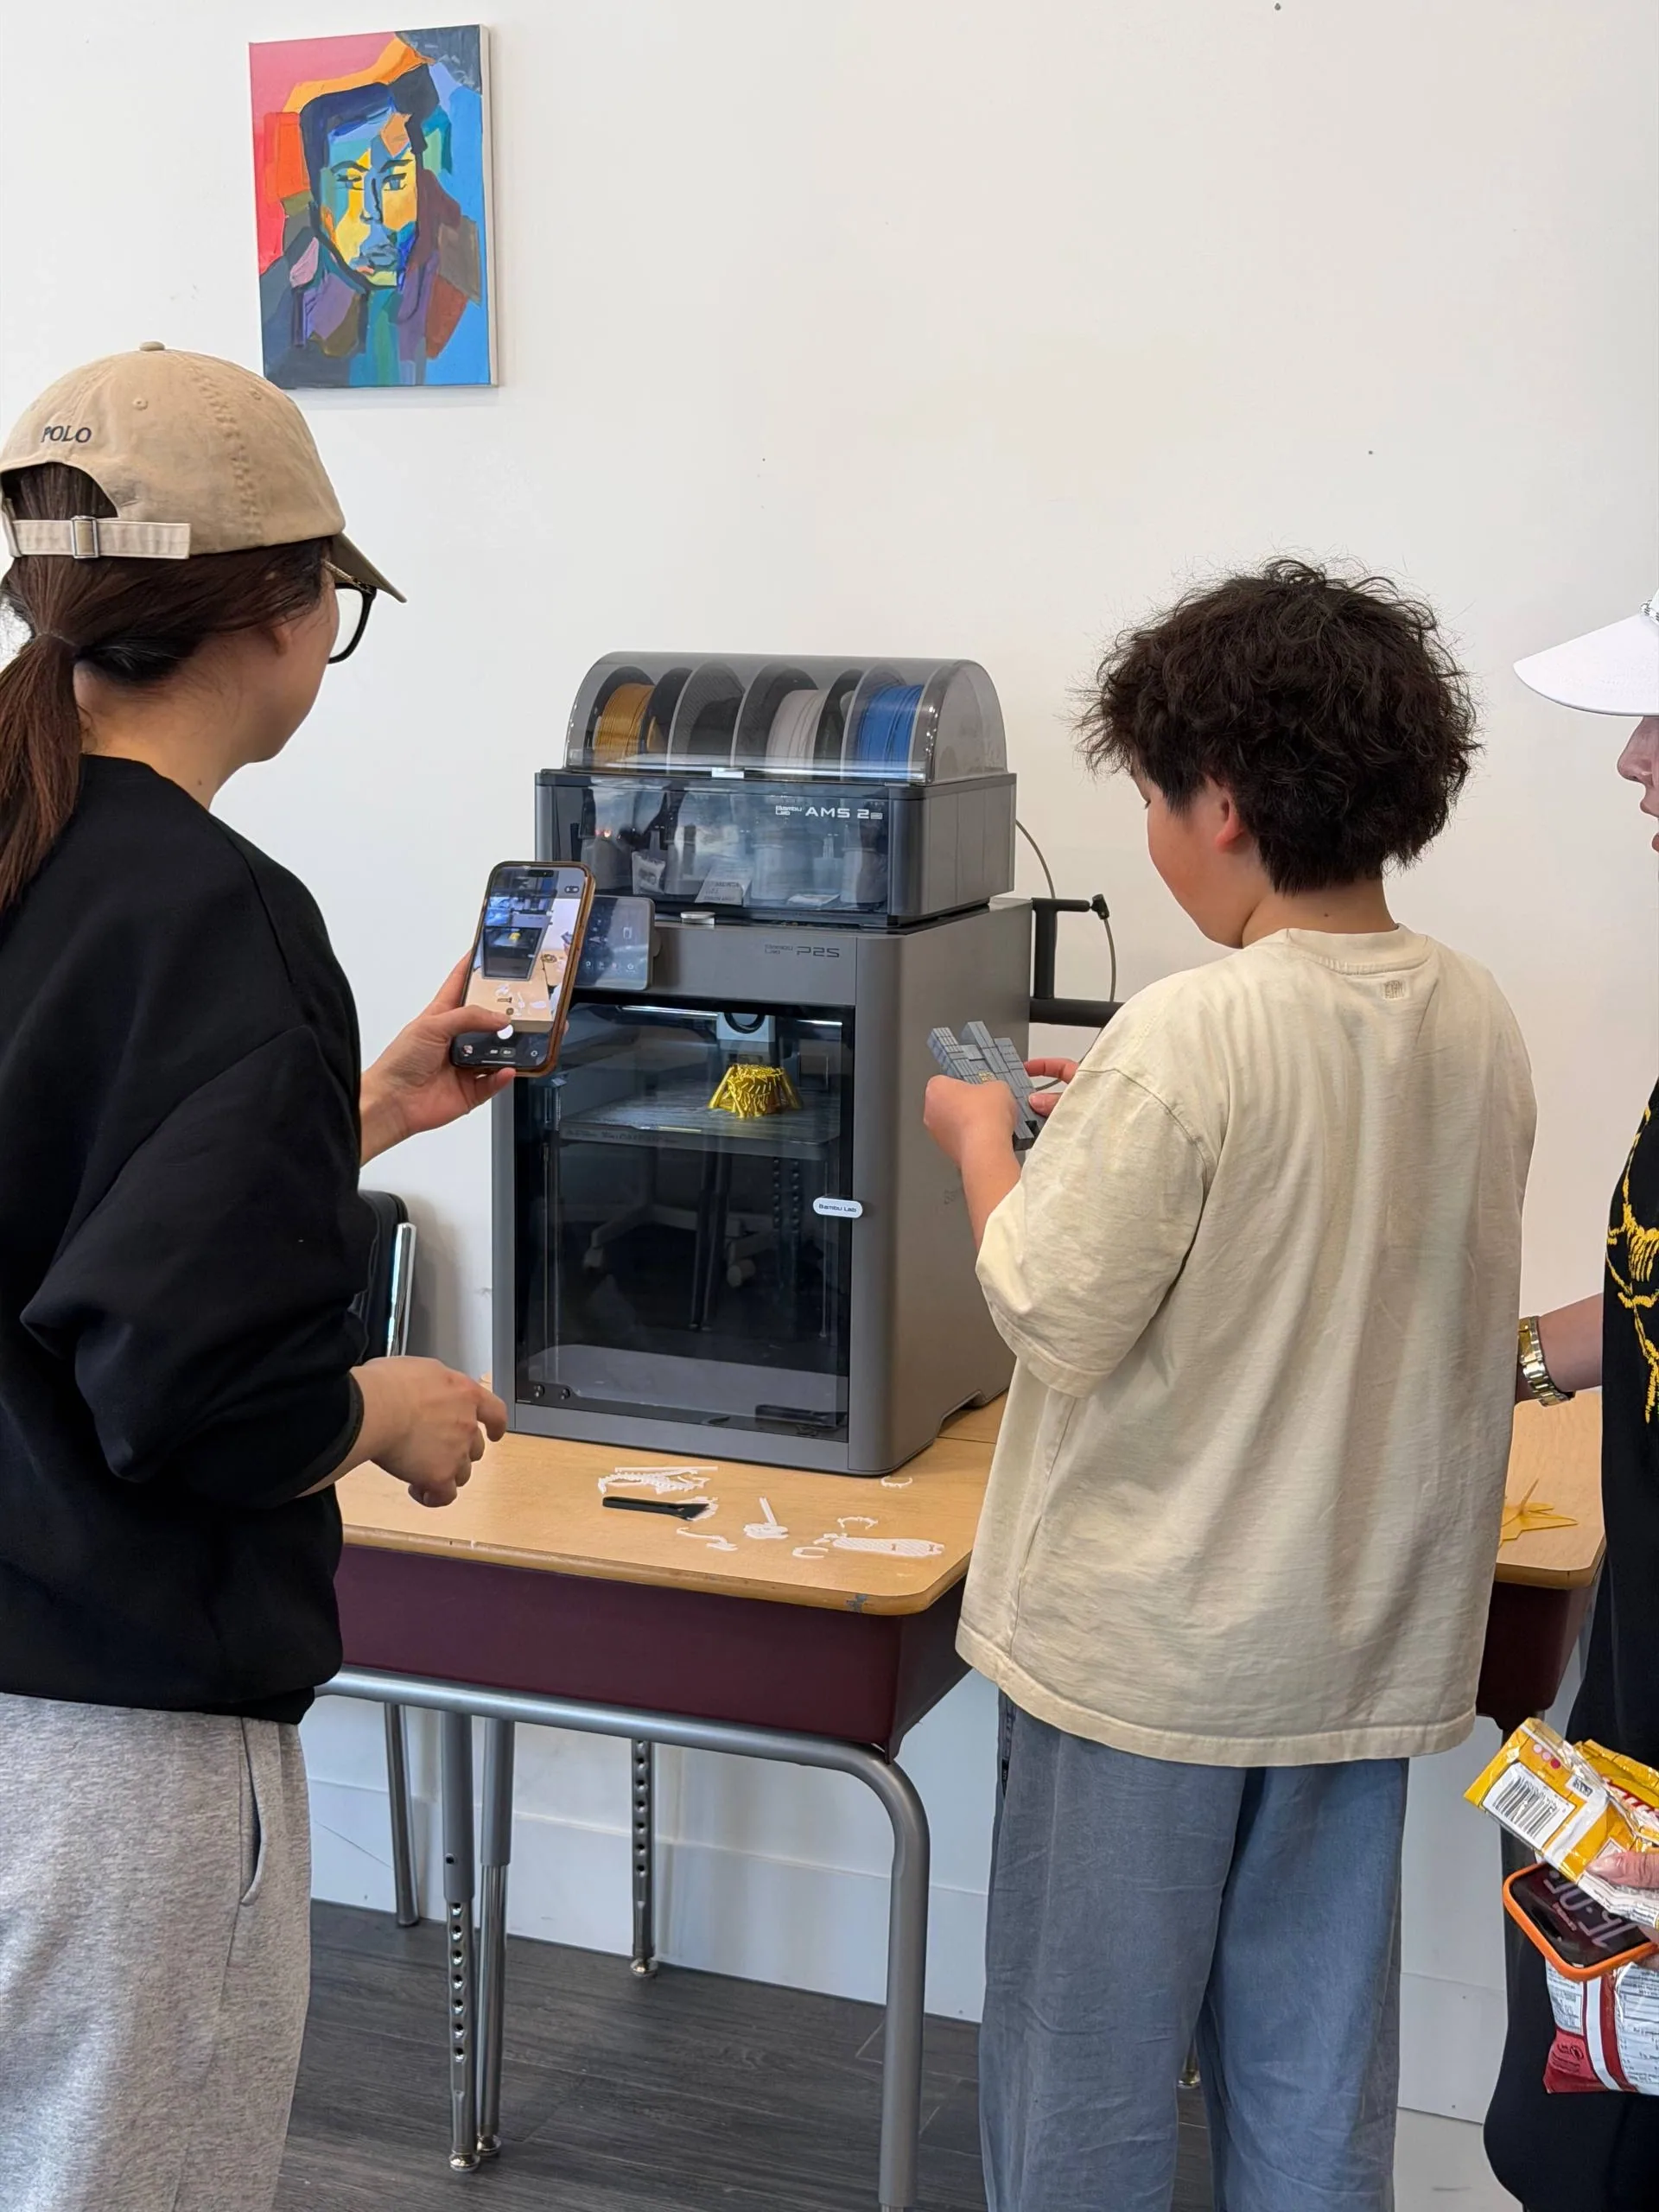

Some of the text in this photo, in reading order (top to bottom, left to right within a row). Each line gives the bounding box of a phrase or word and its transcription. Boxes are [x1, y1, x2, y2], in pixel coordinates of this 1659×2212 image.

[41, 425, 92, 443] POLO
[805, 806, 850, 818] AMS
[857, 809, 869, 819] 2
[797, 945, 840, 958] P2S
[818, 1203, 842, 1211] Bambu
